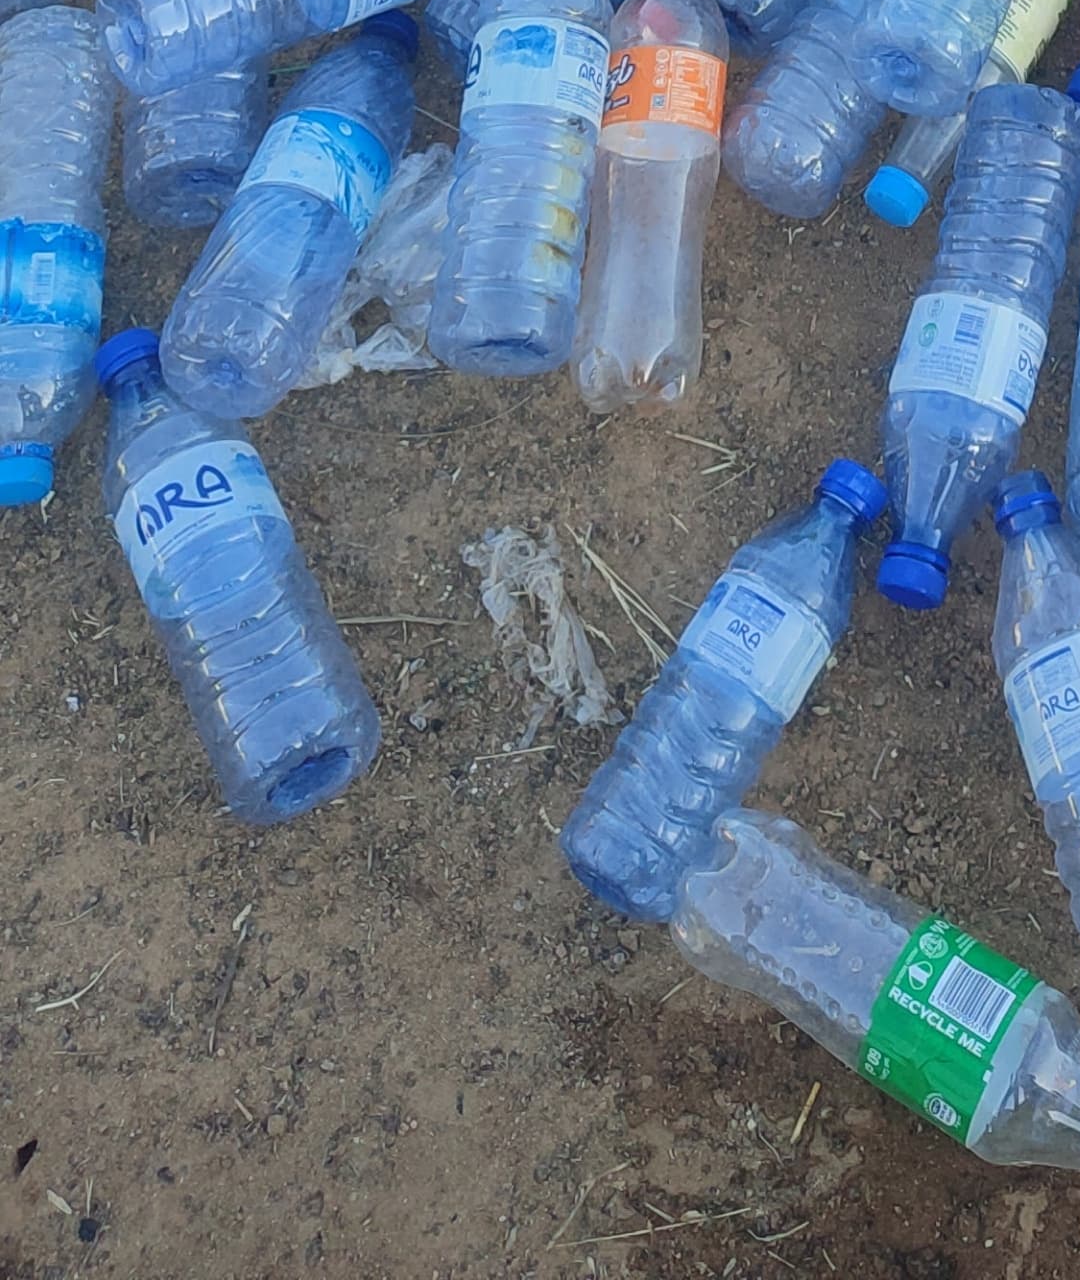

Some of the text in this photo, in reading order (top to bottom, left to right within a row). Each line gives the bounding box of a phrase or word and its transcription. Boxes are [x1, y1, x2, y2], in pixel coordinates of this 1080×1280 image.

[134, 464, 234, 547] ARA
[727, 617, 762, 651] ARA
[887, 985, 957, 1040] RECYCLE
[957, 1030, 987, 1059] ME
